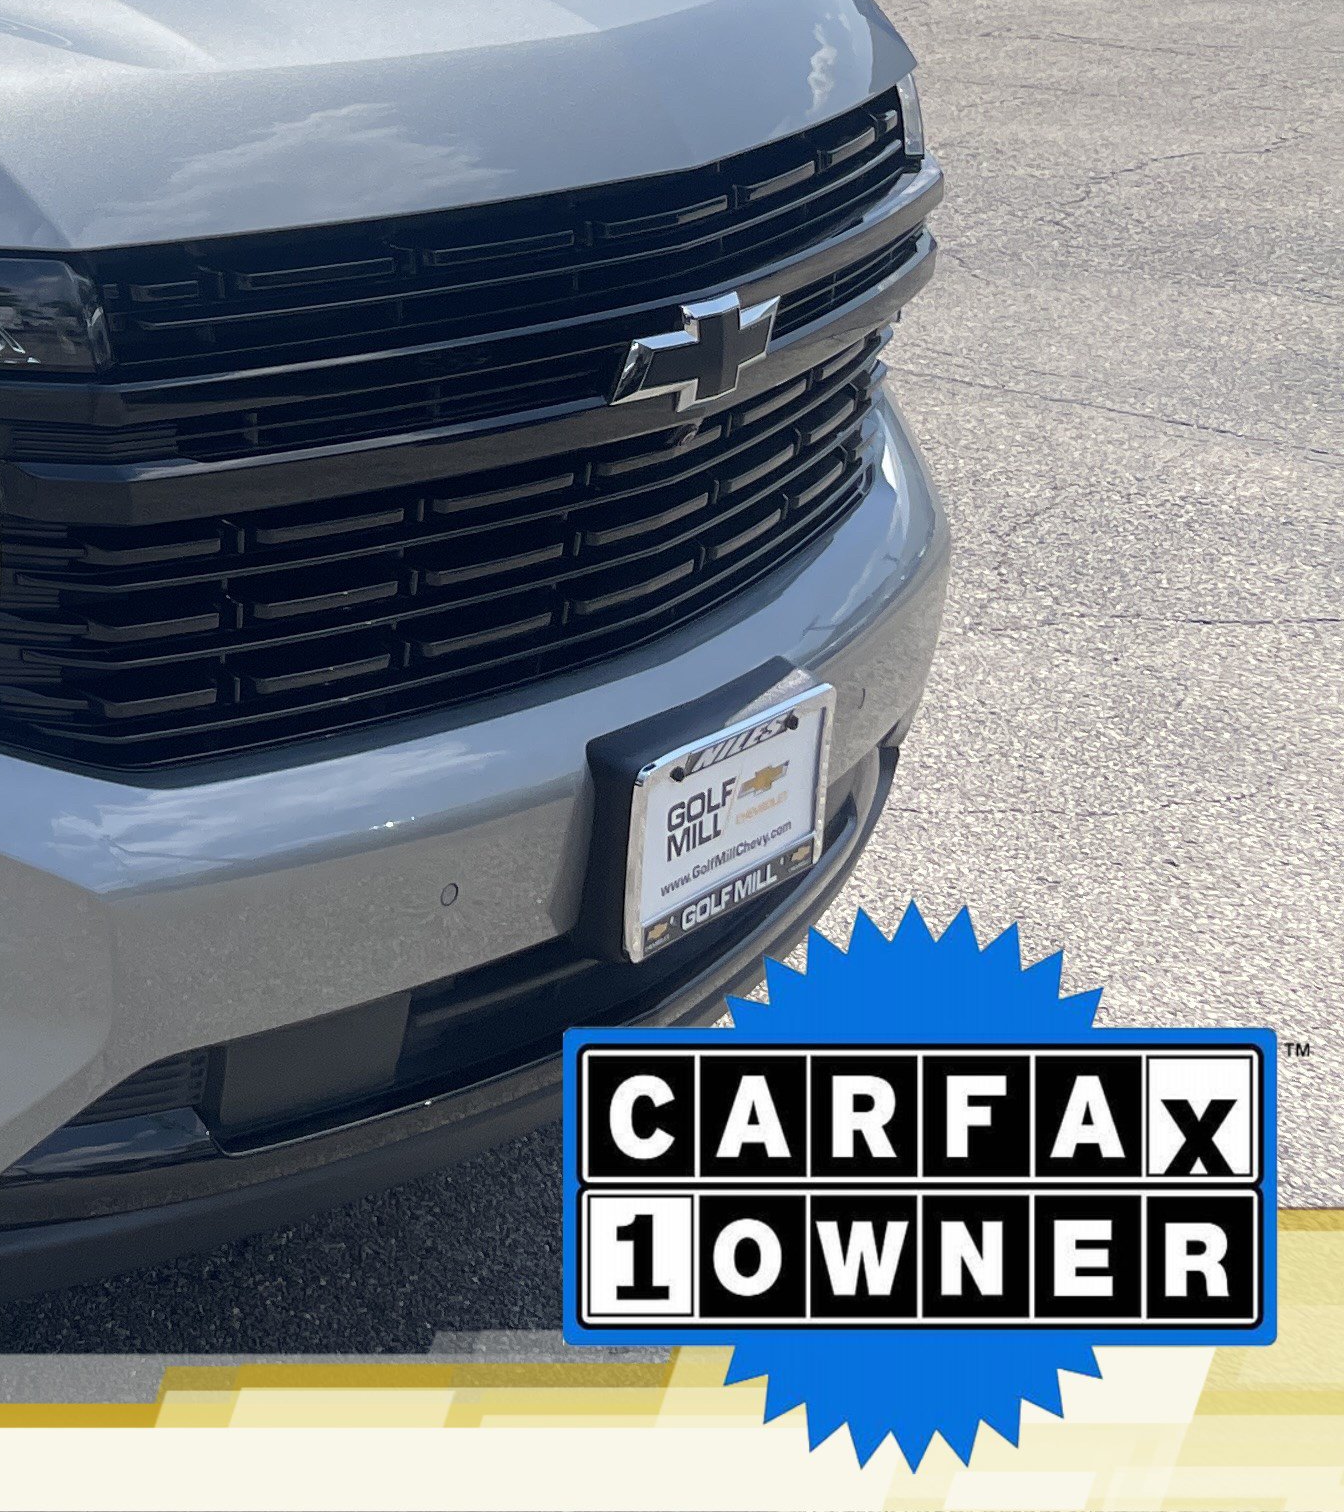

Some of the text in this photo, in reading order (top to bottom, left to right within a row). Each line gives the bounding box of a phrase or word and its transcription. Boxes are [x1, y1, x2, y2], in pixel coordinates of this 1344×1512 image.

[667, 775, 737, 833] GOLF
[667, 813, 722, 863] MILL
[682, 864, 778, 931] GOLF MILL
